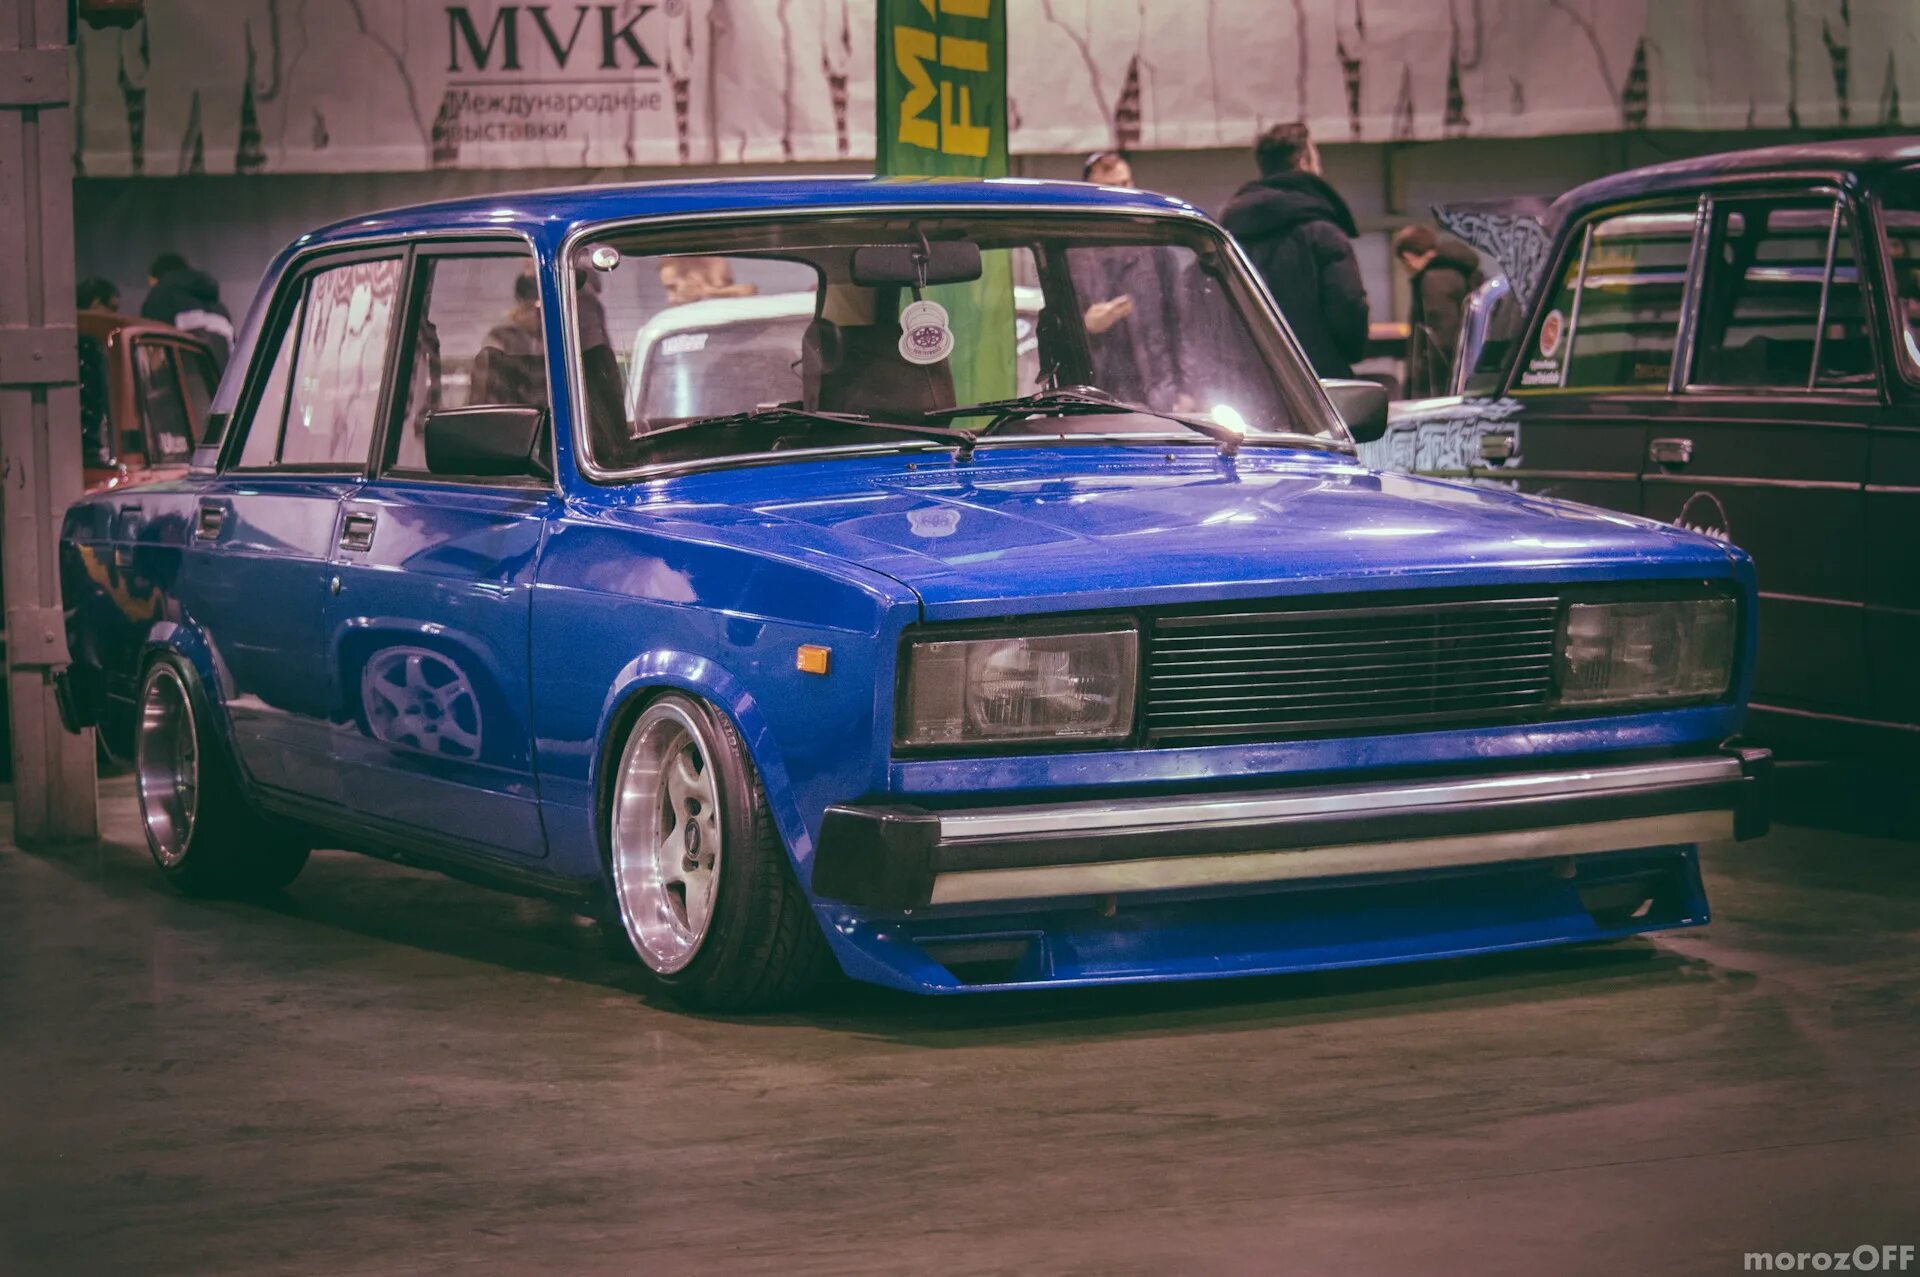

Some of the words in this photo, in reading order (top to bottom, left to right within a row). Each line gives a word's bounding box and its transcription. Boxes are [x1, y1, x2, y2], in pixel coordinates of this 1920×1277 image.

[445, 5, 658, 72] MVK
[893, 0, 938, 151] M
[448, 90, 662, 117] Международные
[447, 121, 567, 141] выставки
